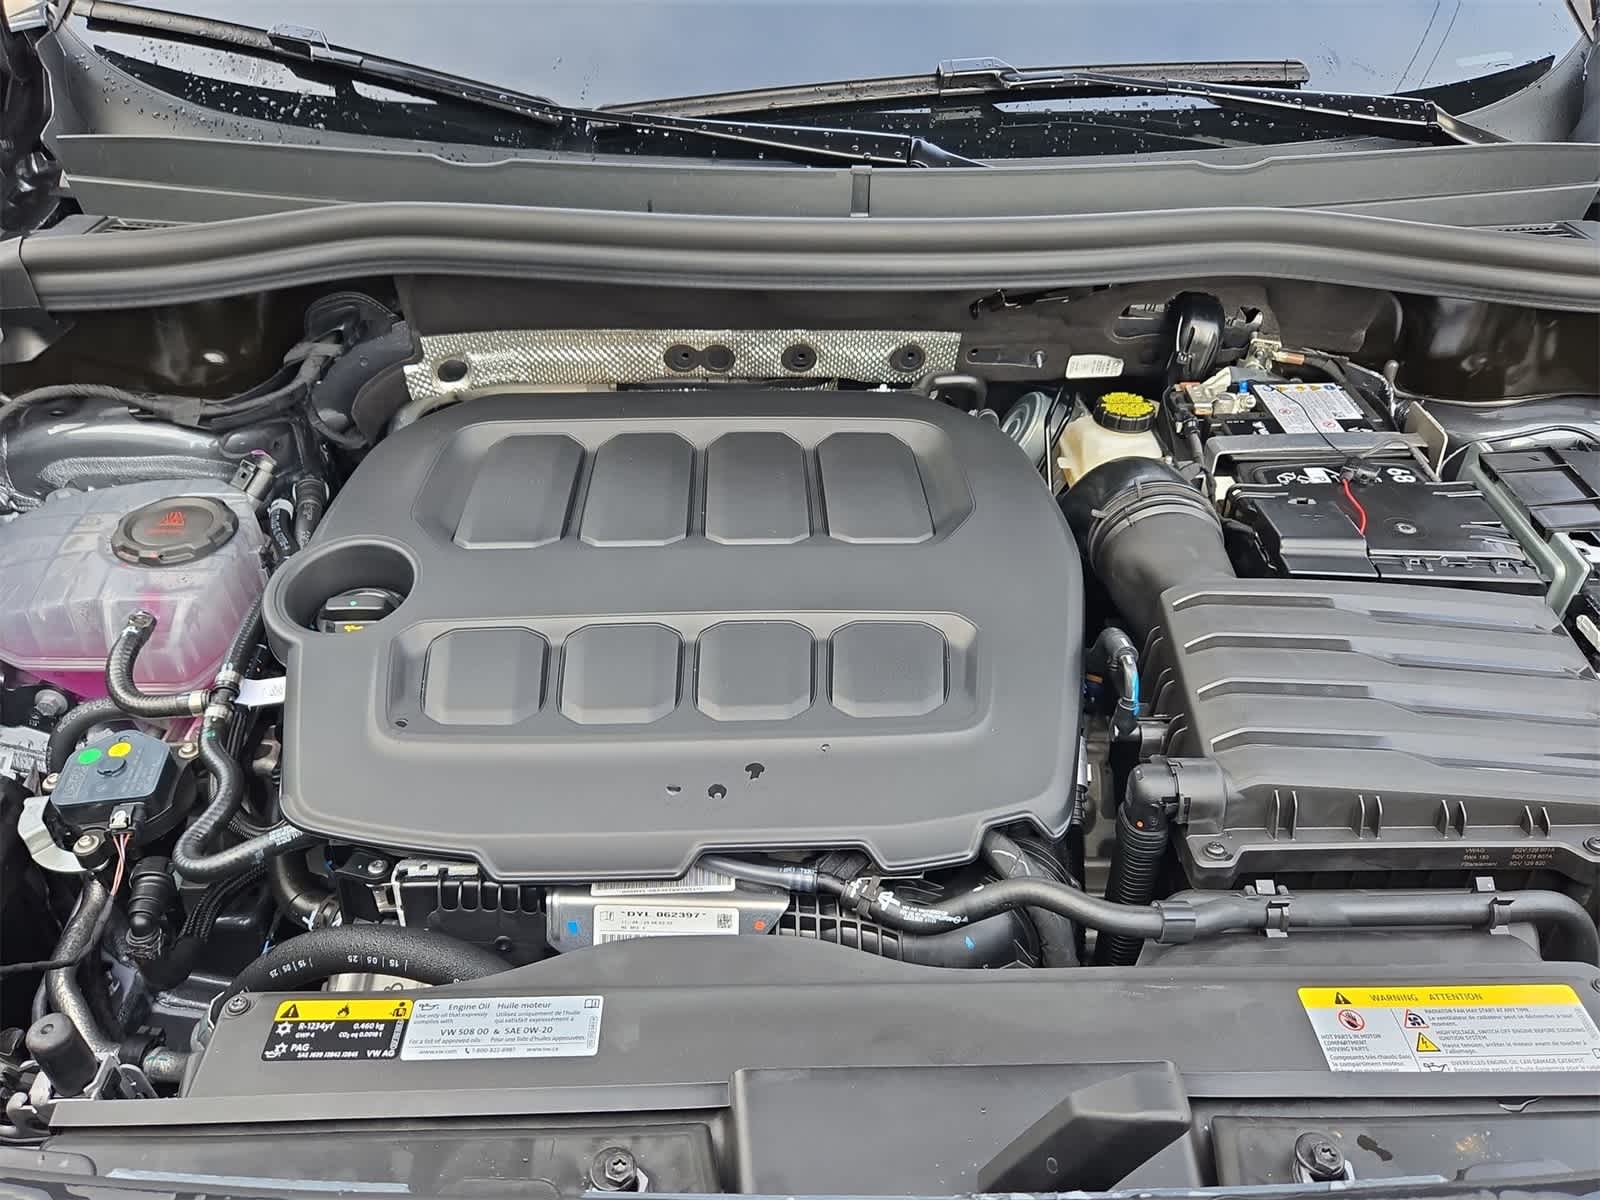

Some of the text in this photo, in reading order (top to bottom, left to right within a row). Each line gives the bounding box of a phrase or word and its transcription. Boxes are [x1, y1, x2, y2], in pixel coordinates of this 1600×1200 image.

[1386, 467, 1417, 483] 68
[1368, 992, 1484, 1002] WARNING ATTENTION
[448, 1002, 491, 1012] Engine Oil
[497, 1001, 552, 1009] Huile moteur
[298, 1021, 336, 1032] R-1234yf
[375, 1022, 385, 1032] kg
[440, 1028, 457, 1036] VW
[458, 1028, 475, 1036] 508
[476, 1027, 490, 1035] 00
[503, 1027, 521, 1035] SAE
[290, 1043, 311, 1052] PAG
[366, 1049, 382, 1058] VW
[381, 1049, 396, 1058] AG
